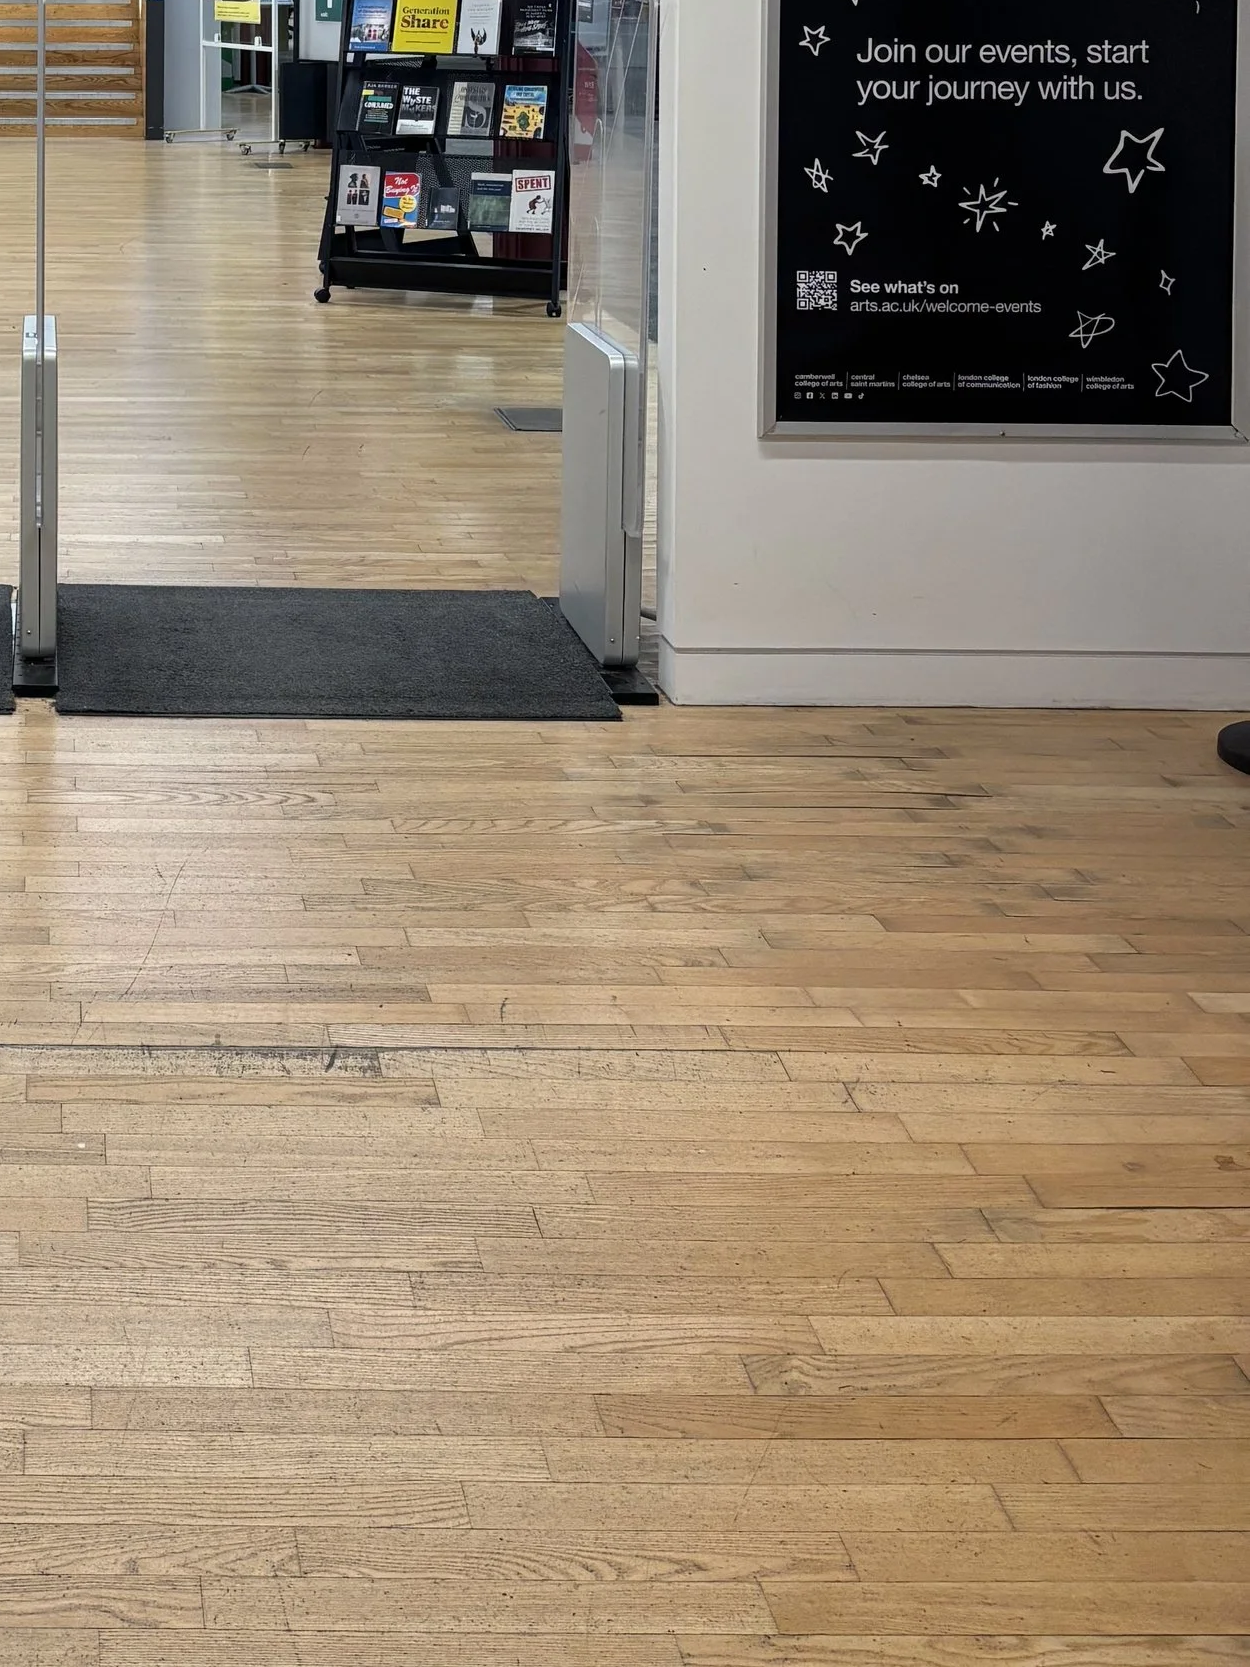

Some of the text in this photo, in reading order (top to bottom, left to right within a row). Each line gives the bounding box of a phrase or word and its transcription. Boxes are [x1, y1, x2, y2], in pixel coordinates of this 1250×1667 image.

[403, 6, 450, 15] Generation
[401, 14, 449, 29] Share
[856, 38, 1149, 68] Join our events, start
[404, 87, 421, 95] THE
[856, 75, 1142, 106] your journey with us.
[518, 178, 548, 189] SPENT
[386, 185, 410, 195] Buying
[850, 280, 958, 294] See what's on
[850, 300, 1042, 313] arts.ac.uk/welcome-events
[984, 374, 1009, 382] college
[1053, 375, 1079, 383] college
[795, 380, 820, 388] college
